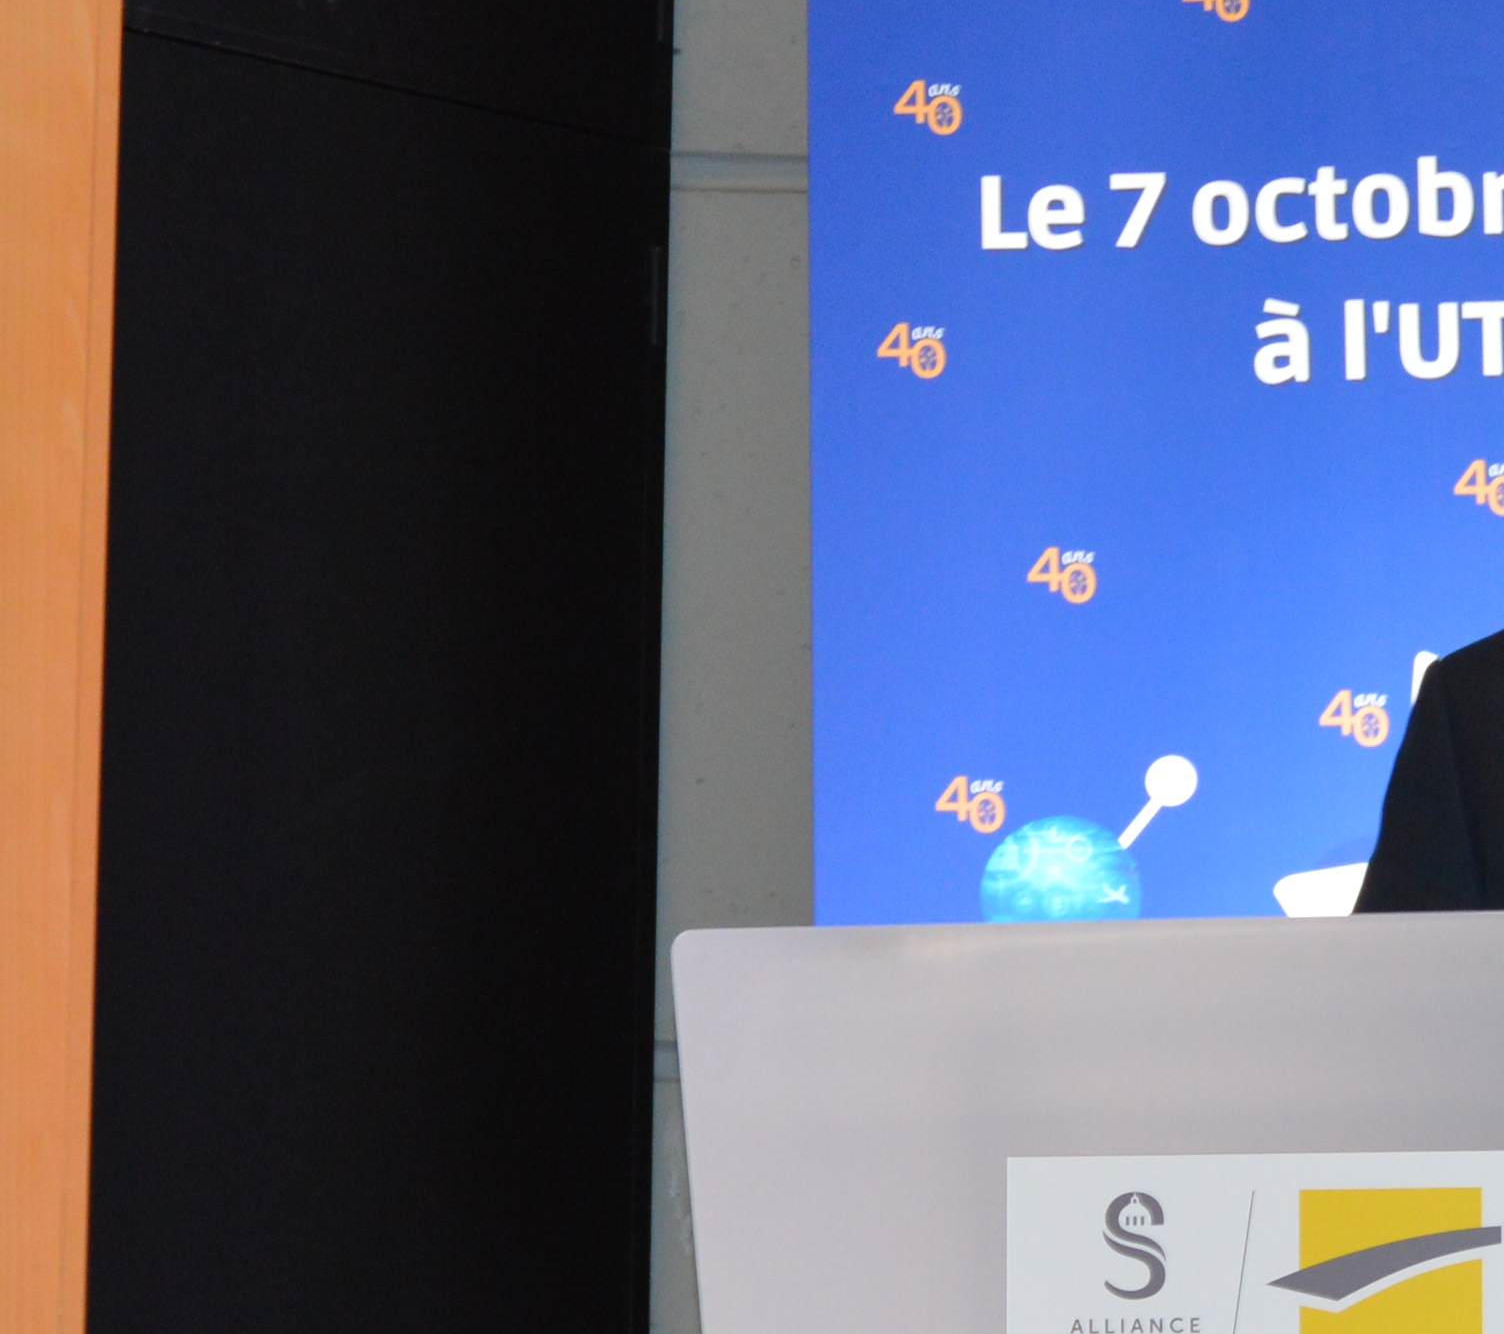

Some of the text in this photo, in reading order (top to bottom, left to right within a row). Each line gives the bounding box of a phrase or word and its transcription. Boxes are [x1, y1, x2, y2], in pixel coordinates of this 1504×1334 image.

[894, 81, 962, 135] 40
[979, 174, 1085, 252] Le
[1108, 172, 1167, 249] 7
[877, 323, 945, 379] 40
[1253, 299, 1309, 385] à
[1028, 548, 1096, 604] 40
[1320, 691, 1388, 747] 40
[936, 777, 1004, 833] 40
[1070, 1317, 1201, 1334] ALLIANCE
